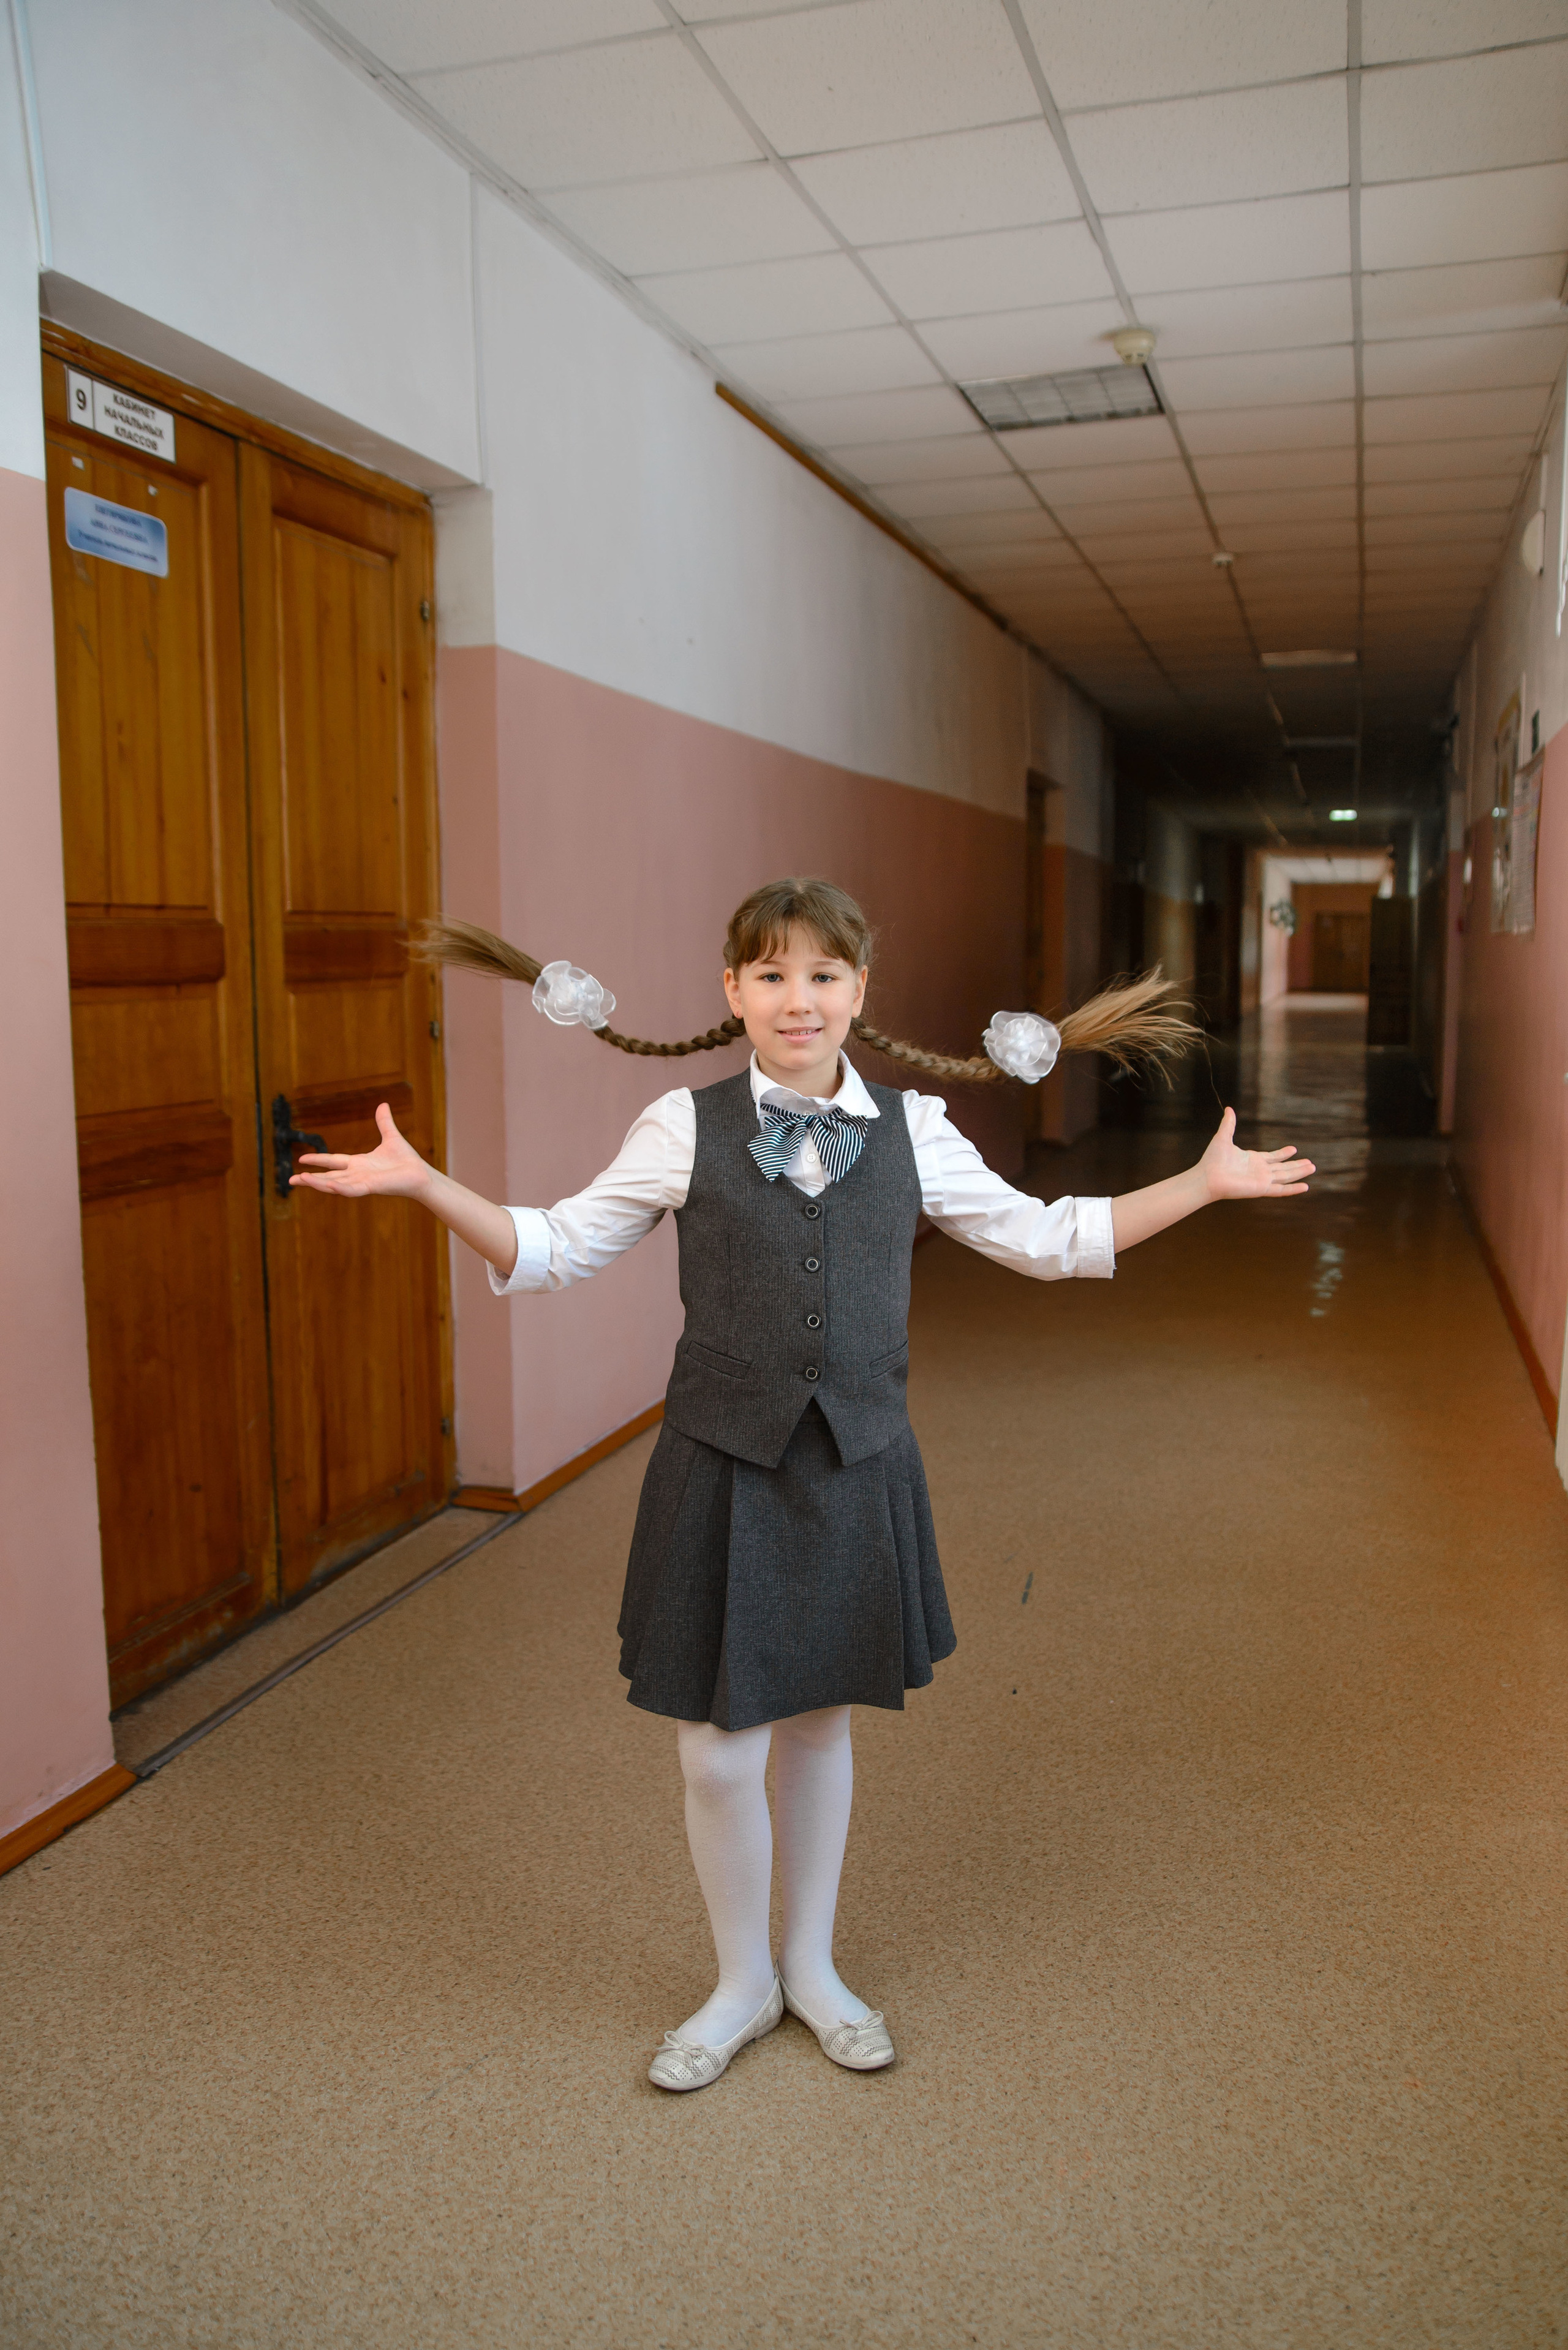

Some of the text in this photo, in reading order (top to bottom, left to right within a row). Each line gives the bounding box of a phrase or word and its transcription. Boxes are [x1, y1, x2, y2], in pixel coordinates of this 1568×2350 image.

[76, 388, 86, 410] 9
[113, 393, 156, 420] КАБИНЕТ
[104, 404, 164, 439] НАЧАЛЬНЫХ
[115, 425, 158, 451] КЛАССОВ
